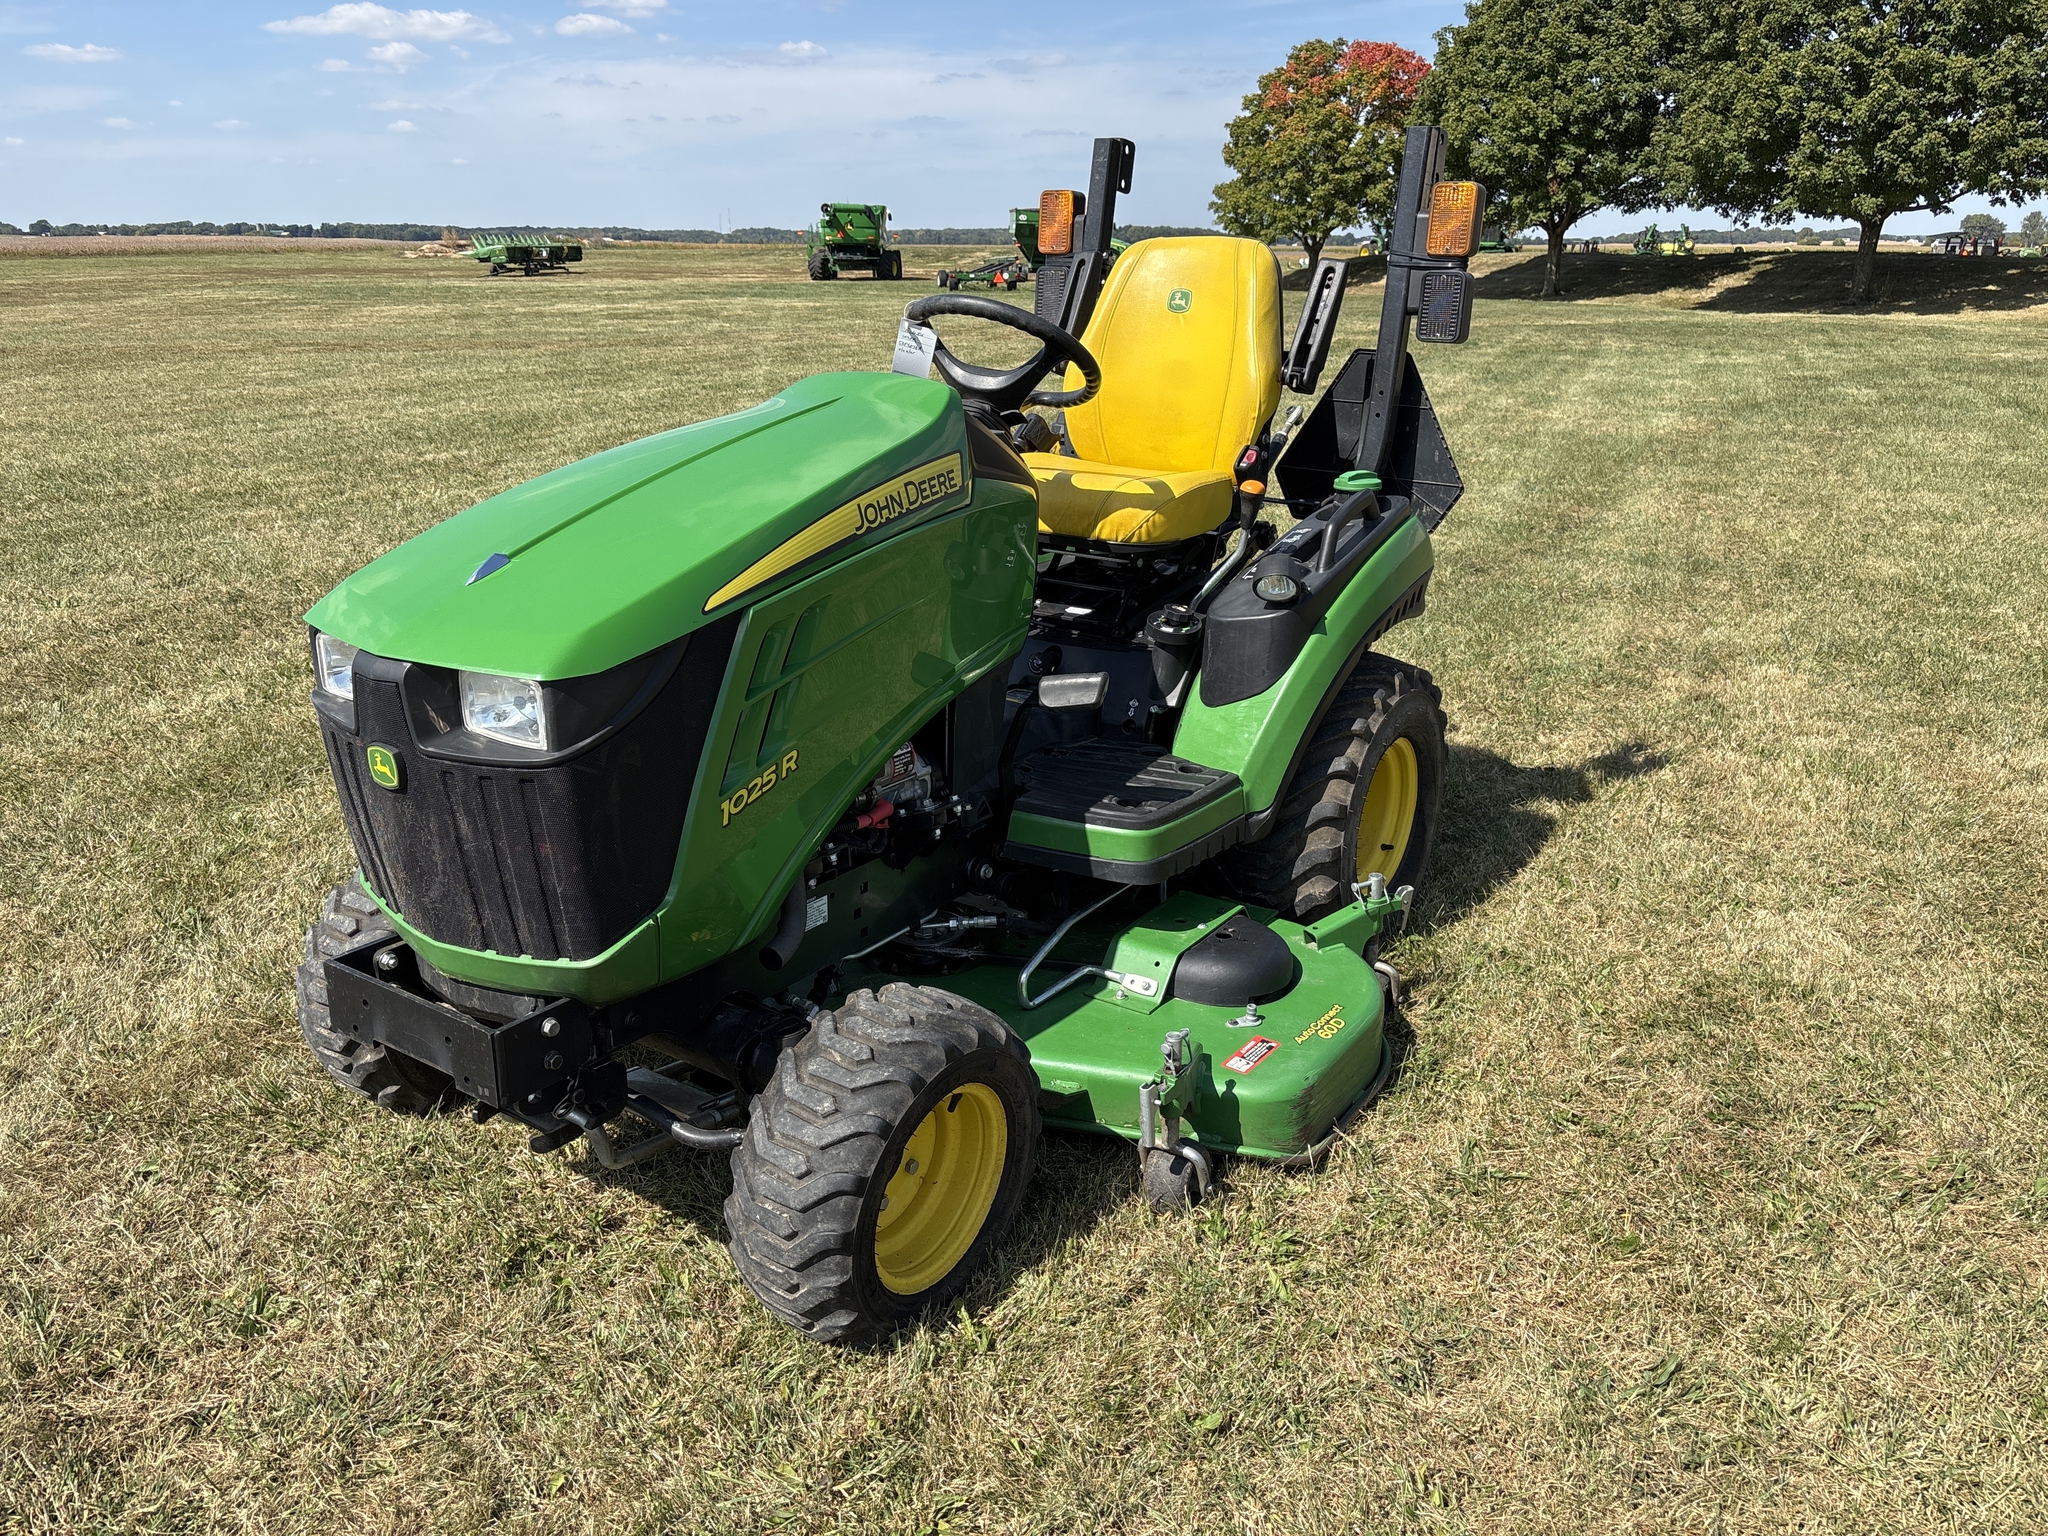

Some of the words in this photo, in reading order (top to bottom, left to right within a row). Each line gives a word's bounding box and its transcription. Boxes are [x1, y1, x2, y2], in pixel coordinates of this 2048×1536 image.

[855, 490, 904, 533] JOHN
[904, 469, 958, 507] DEERE
[721, 763, 778, 828] 1025
[782, 749, 799, 779] R
[1294, 1003, 1344, 1045] AutoConnect
[1317, 1017, 1346, 1039] 60D
